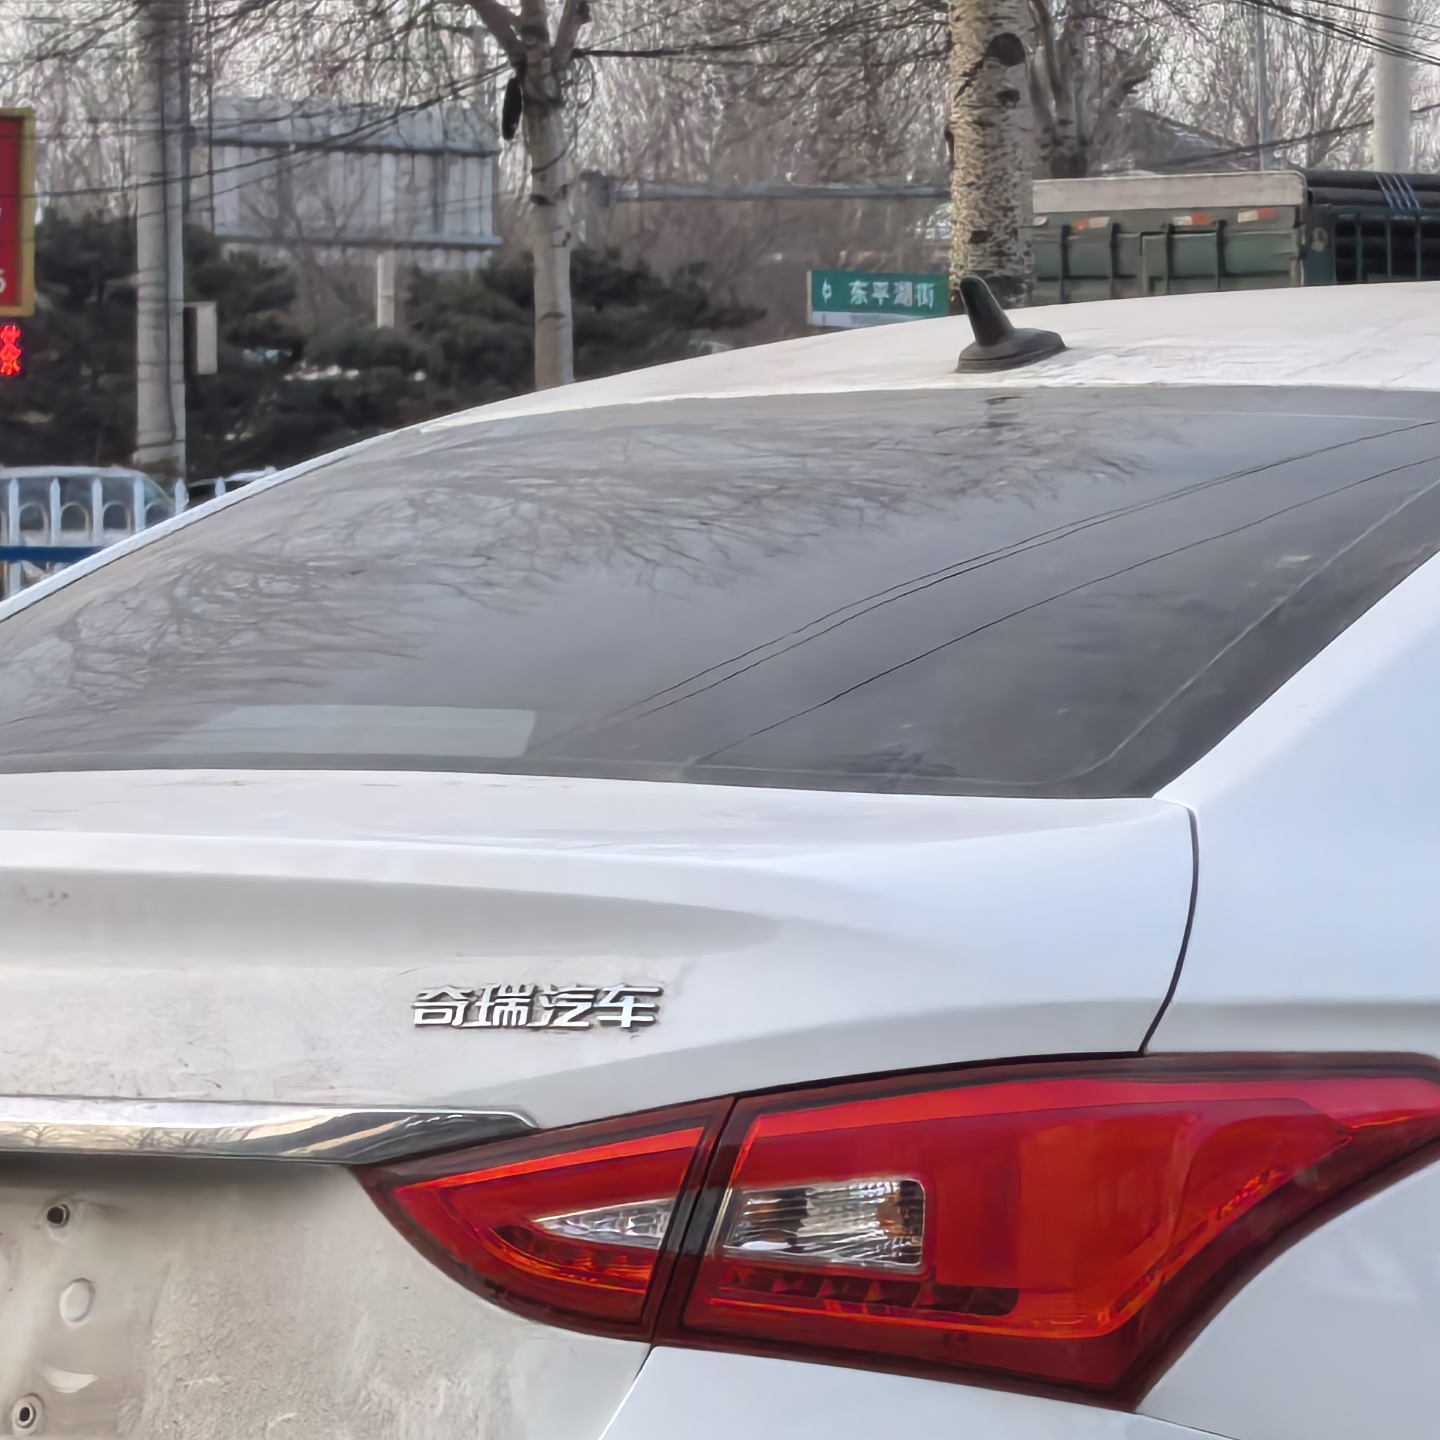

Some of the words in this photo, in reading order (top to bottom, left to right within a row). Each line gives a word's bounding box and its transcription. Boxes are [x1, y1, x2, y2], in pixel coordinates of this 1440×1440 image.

[848, 280, 935, 308] 东平湖街
[412, 983, 664, 1030] 奇瑞汽车
